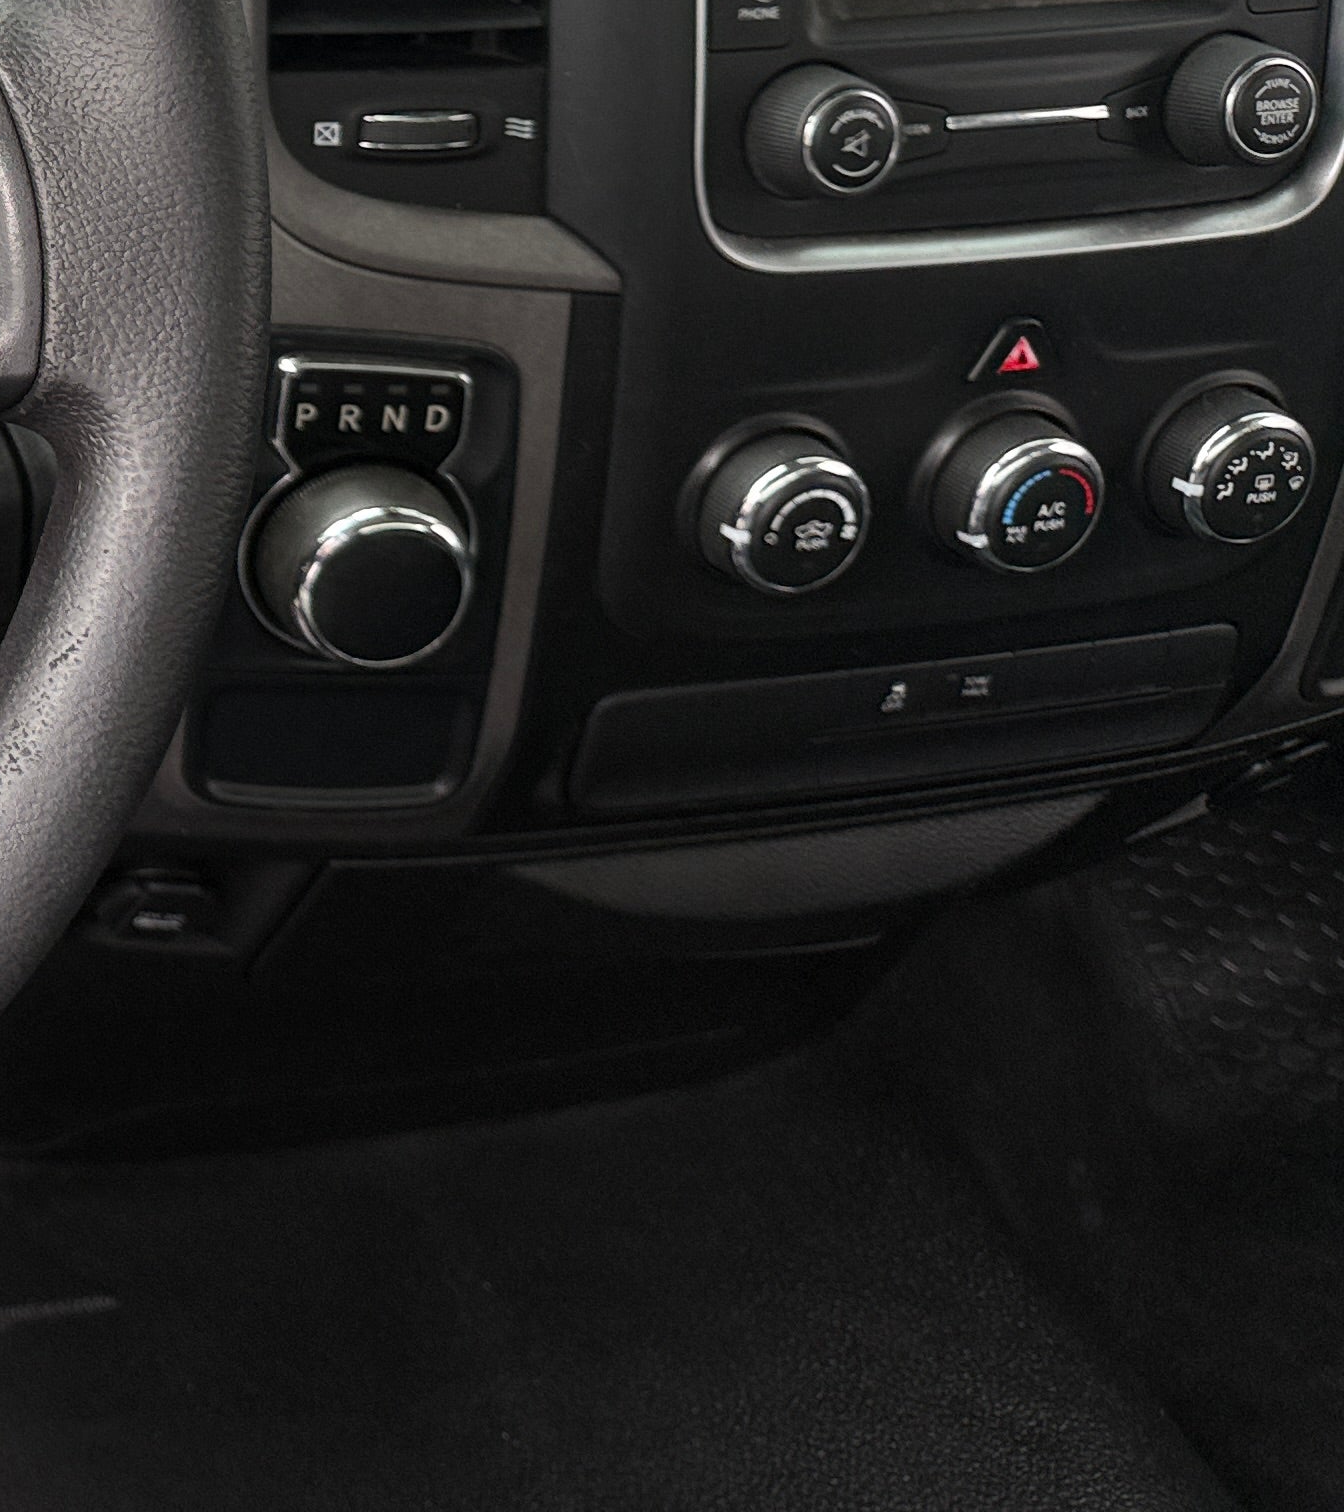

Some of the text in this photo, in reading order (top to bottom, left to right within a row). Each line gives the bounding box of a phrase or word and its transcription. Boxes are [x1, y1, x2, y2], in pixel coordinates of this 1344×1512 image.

[1265, 78, 1291, 89] TUNE
[1255, 97, 1300, 110] BROWSE
[1260, 112, 1295, 126] ENTER
[1259, 130, 1295, 144] SCROLL
[294, 402, 451, 433] P R N D
[1246, 491, 1277, 504] PUSH
[1037, 501, 1067, 518] A/C
